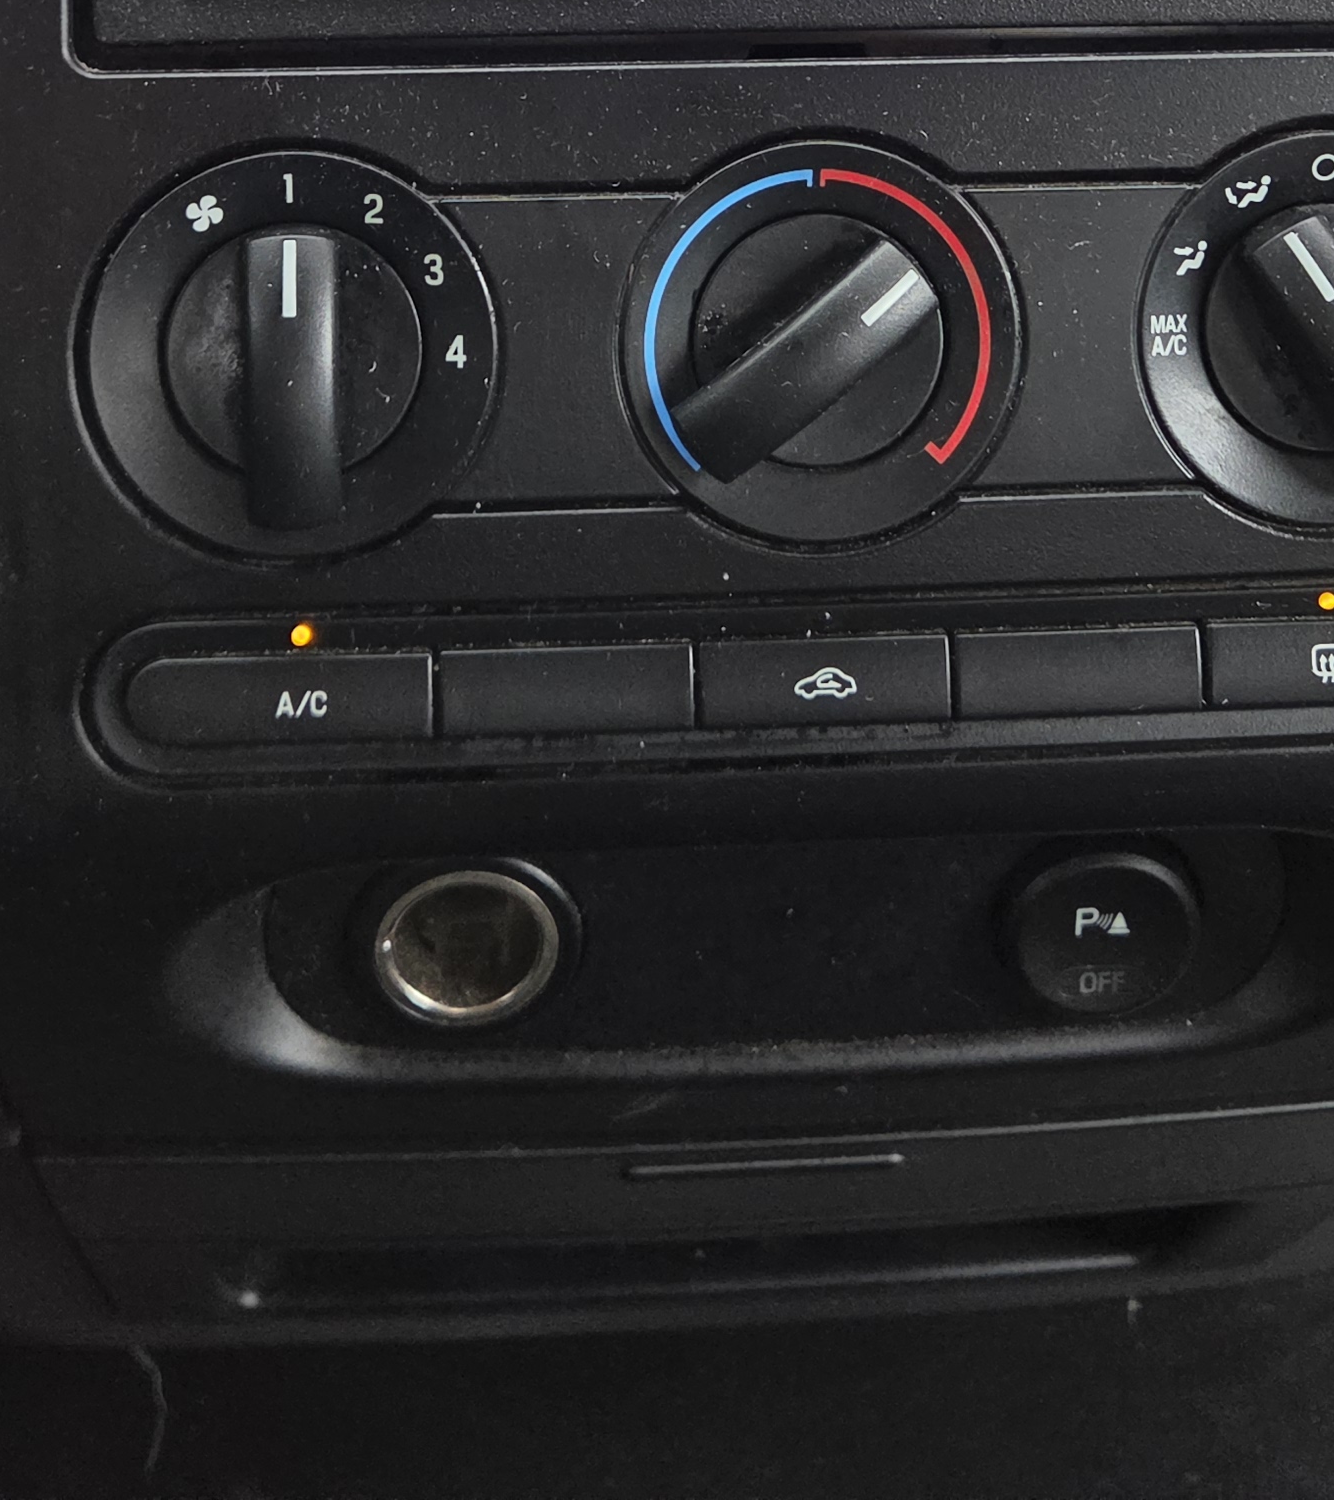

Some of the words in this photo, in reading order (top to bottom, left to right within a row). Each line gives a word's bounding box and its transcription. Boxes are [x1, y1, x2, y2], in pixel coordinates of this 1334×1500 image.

[282, 173, 294, 204] 1
[363, 193, 384, 225] 2
[423, 253, 444, 286] 3
[1150, 314, 1187, 334] MAX
[445, 334, 467, 369] 4
[1151, 335, 1187, 357] A/C
[275, 690, 328, 719] A/C
[1079, 972, 1125, 994] OFF
